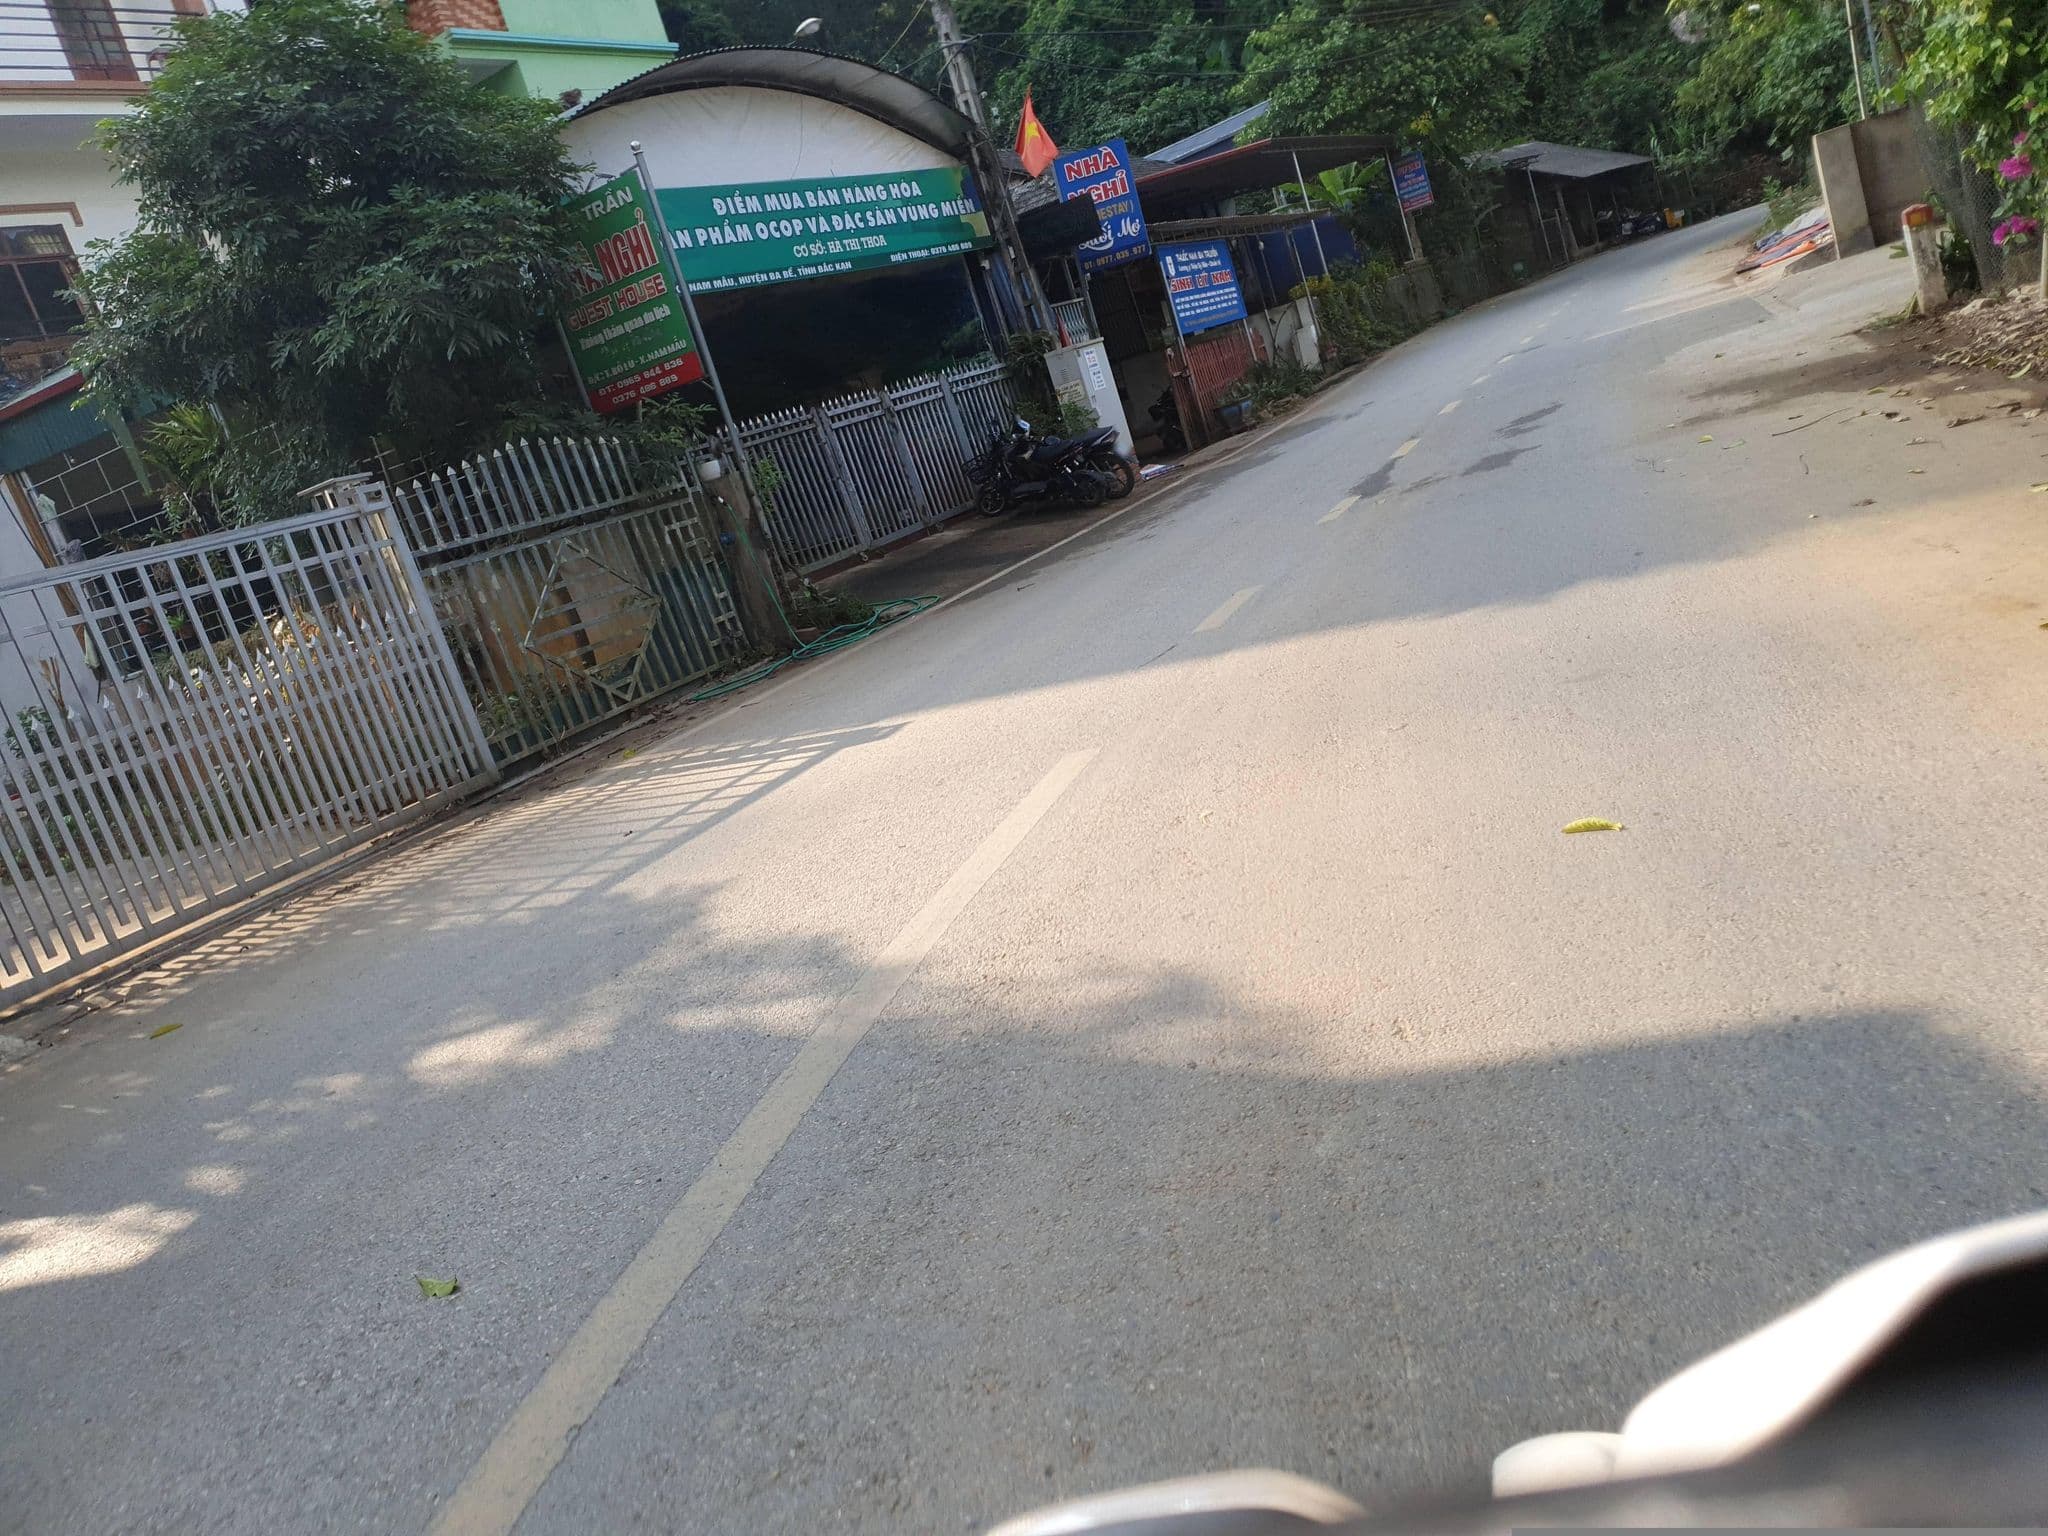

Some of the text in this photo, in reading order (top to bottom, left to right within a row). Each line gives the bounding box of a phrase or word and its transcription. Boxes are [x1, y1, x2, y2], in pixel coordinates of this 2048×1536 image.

[1064, 146, 1120, 182] NHÀ
[712, 179, 922, 216] ĐIỂM MUA BÁN HÀNG HÓA
[695, 219, 754, 246] PHẨM
[755, 218, 803, 240] OCOP
[805, 213, 831, 234] VÀ
[832, 210, 865, 234] ĐẶC
[866, 206, 898, 228] SẢN
[898, 202, 939, 223] VÙNG
[941, 193, 976, 217] MIỀN
[594, 207, 659, 285] NGHỈ
[828, 237, 844, 253] HÀ
[844, 238, 861, 253] THỊ
[860, 234, 887, 250] THOA
[688, 279, 712, 292] NAM
[769, 271, 782, 281] BA
[1210, 269, 1234, 285] NAM
[568, 272, 667, 331] GUEST HOUSE
[624, 316, 644, 334] quan
[643, 311, 655, 324] du
[653, 303, 671, 321] lịch
